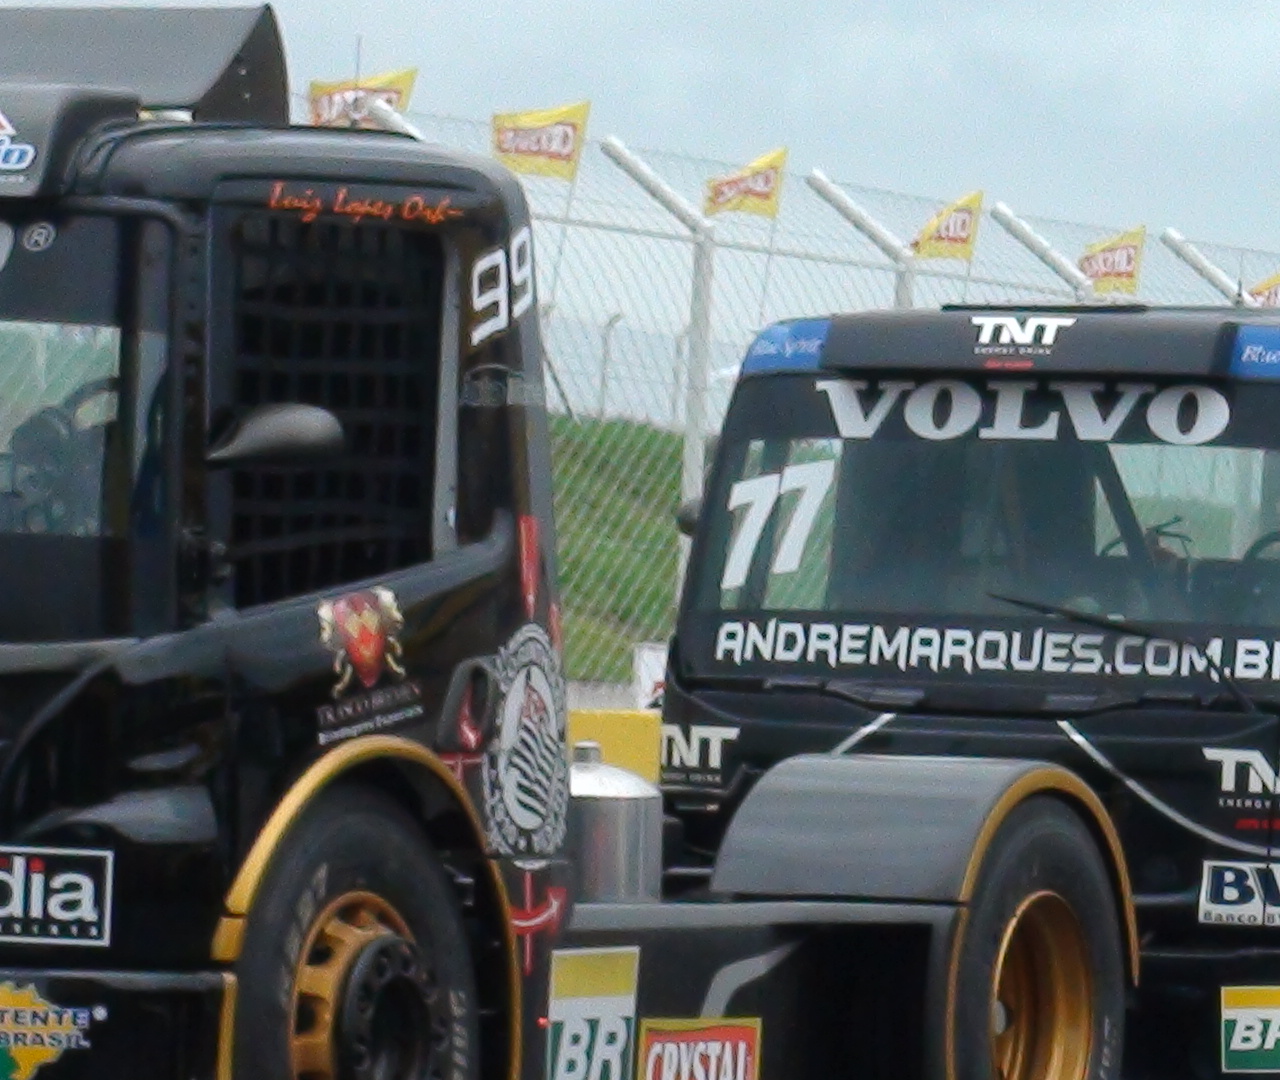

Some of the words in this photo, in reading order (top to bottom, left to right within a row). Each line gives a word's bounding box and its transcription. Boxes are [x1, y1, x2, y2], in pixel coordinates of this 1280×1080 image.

[470, 226, 533, 347] 99
[972, 316, 1077, 345] TNT
[815, 379, 1230, 444] VOLVO
[721, 459, 836, 590] 77
[1218, 798, 1271, 809] ENERGY
[0, 855, 98, 923] dia
[1203, 911, 1258, 924] Banco
